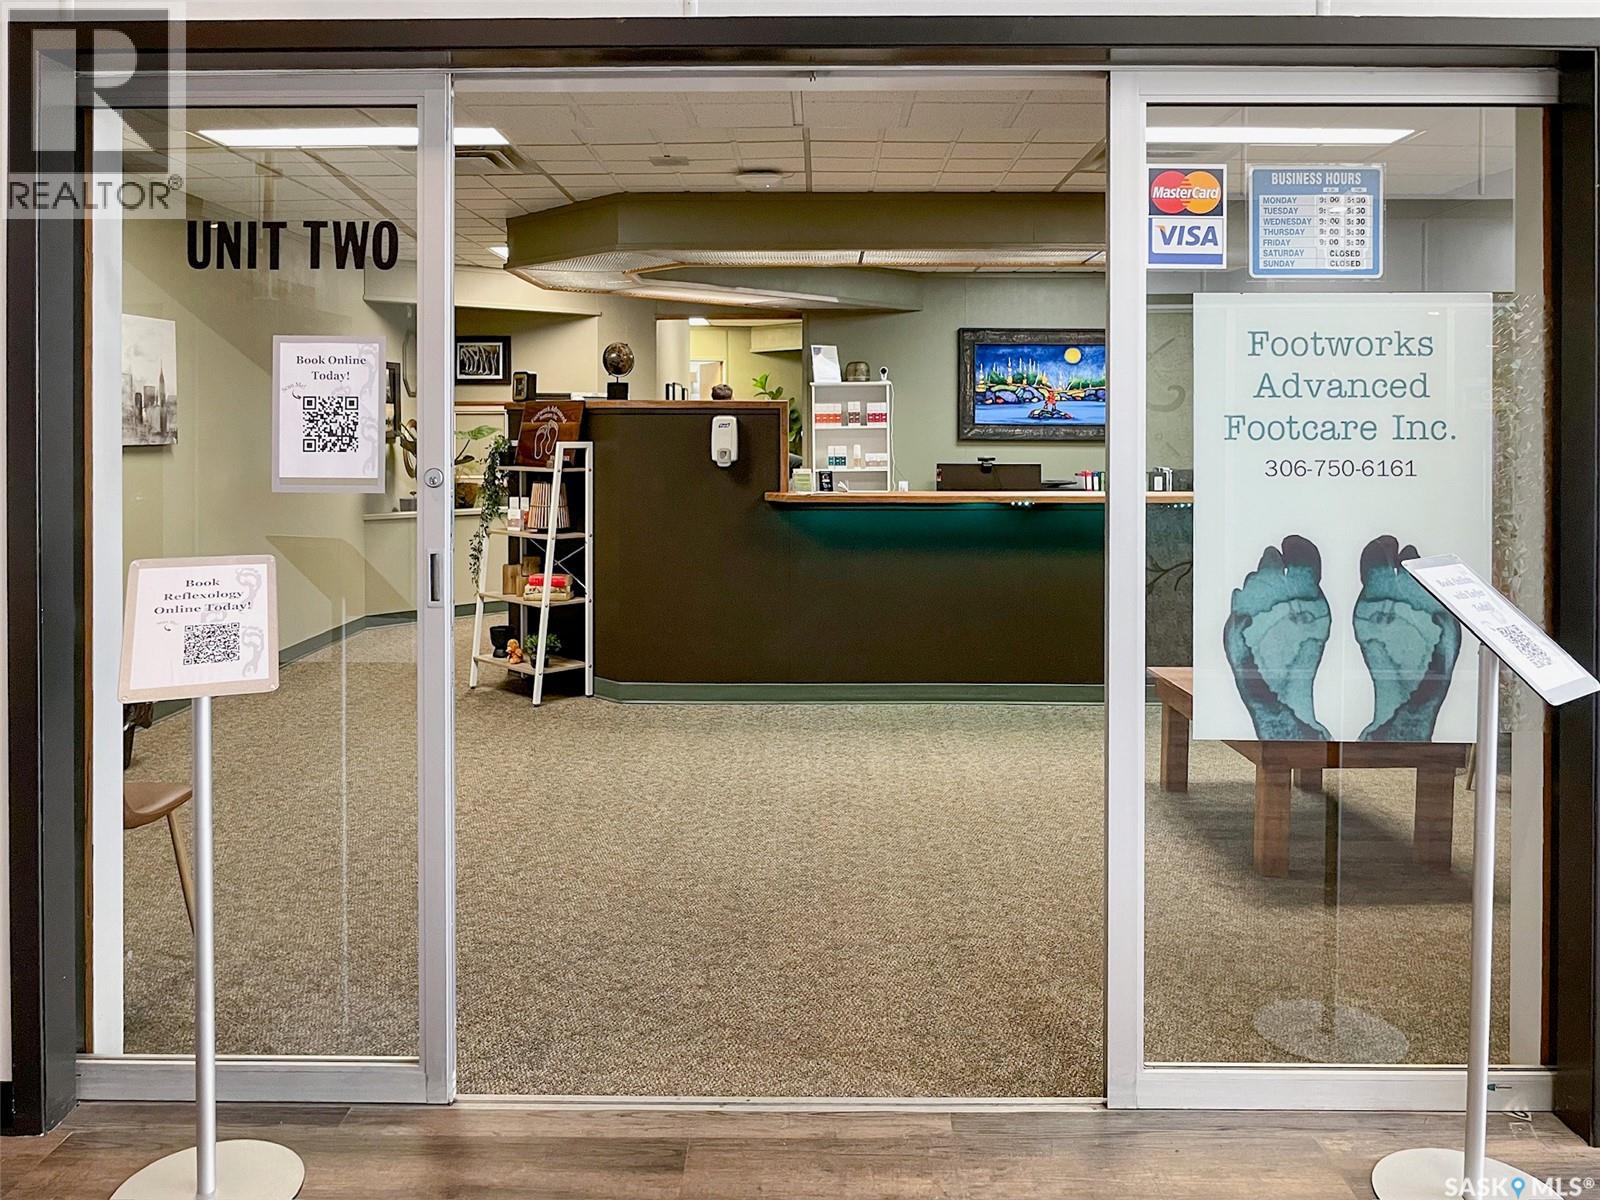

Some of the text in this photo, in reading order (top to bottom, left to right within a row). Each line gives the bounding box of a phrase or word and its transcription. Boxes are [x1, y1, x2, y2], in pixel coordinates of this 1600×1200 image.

[1271, 172, 1361, 185] BUSINESS HOURS
[1152, 186, 1219, 199] MasterCard
[1263, 196, 1297, 204] MONDAY
[1263, 207, 1298, 215] TUESDAY
[1263, 217, 1312, 225] WEDNESDAY
[1155, 224, 1218, 246] VISA
[1263, 228, 1305, 236] THURSDAY
[187, 220, 399, 270] UNIT TWO
[1263, 249, 1305, 257] SATURDAY
[1247, 330, 1433, 358] Footworks
[296, 355, 367, 365] Book Online
[311, 370, 350, 382] Today!
[1252, 372, 1430, 399] Advanced
[1223, 414, 1456, 441] Footcare Inc.
[1264, 459, 1418, 477] 306-750-6161
[186, 578, 220, 588] Book
[164, 590, 244, 601] Reflexology
[154, 601, 252, 615] Online Today!
